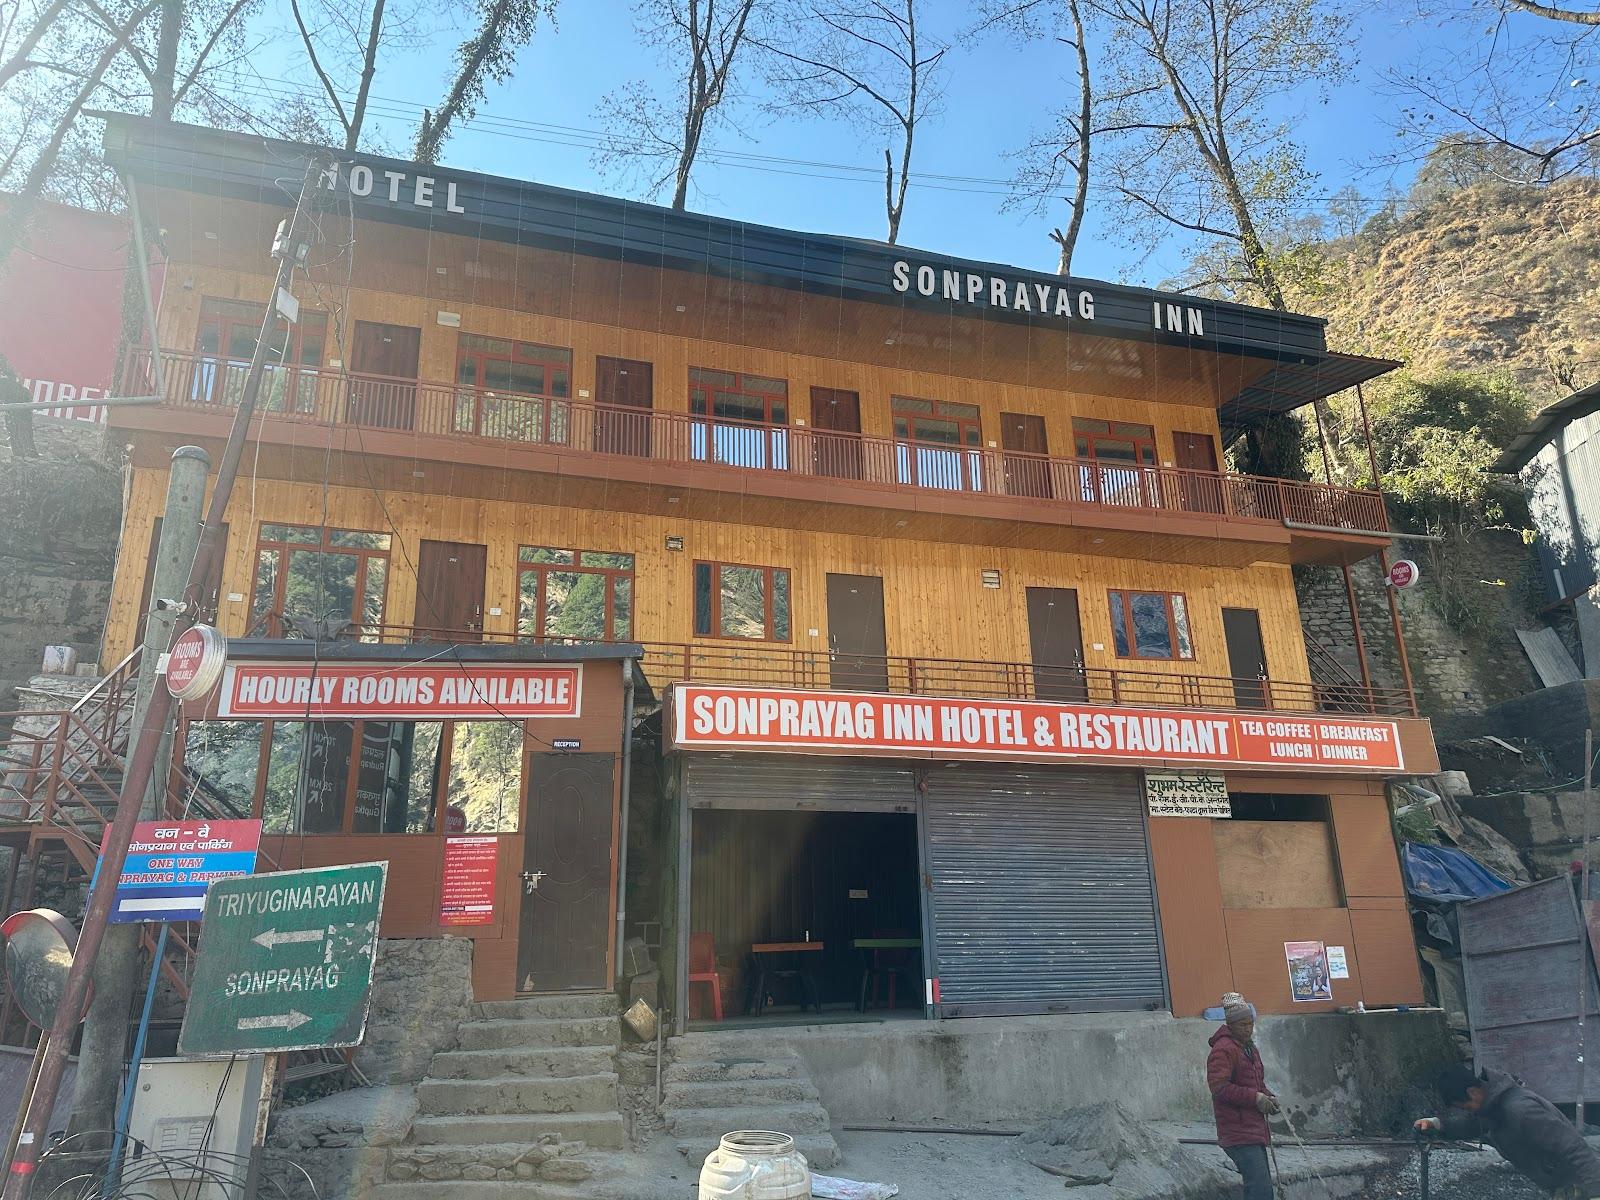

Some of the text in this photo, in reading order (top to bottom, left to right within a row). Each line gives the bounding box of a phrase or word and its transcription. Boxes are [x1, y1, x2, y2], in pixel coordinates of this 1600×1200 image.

[892, 261, 1204, 336] SONPRAYAG INN
[175, 642, 202, 659] ROOMS
[238, 676, 570, 705] HOURLY ROOMS AVAILABLE
[693, 695, 1230, 755] SONPRAYAG INN HOTEL & RESTAURANT
[1240, 720, 1389, 742] TEA COFFEE BREAKFAST
[1270, 742, 1368, 760] LUNCH DINNER
[155, 827, 180, 839] वन
[197, 823, 211, 839] वे
[179, 840, 197, 851] एवं
[148, 857, 204, 869] ONE WAY
[177, 871, 187, 882] &
[217, 880, 375, 917] TRIYUGINARAYAN
[225, 963, 340, 998] SONPRAYAG
